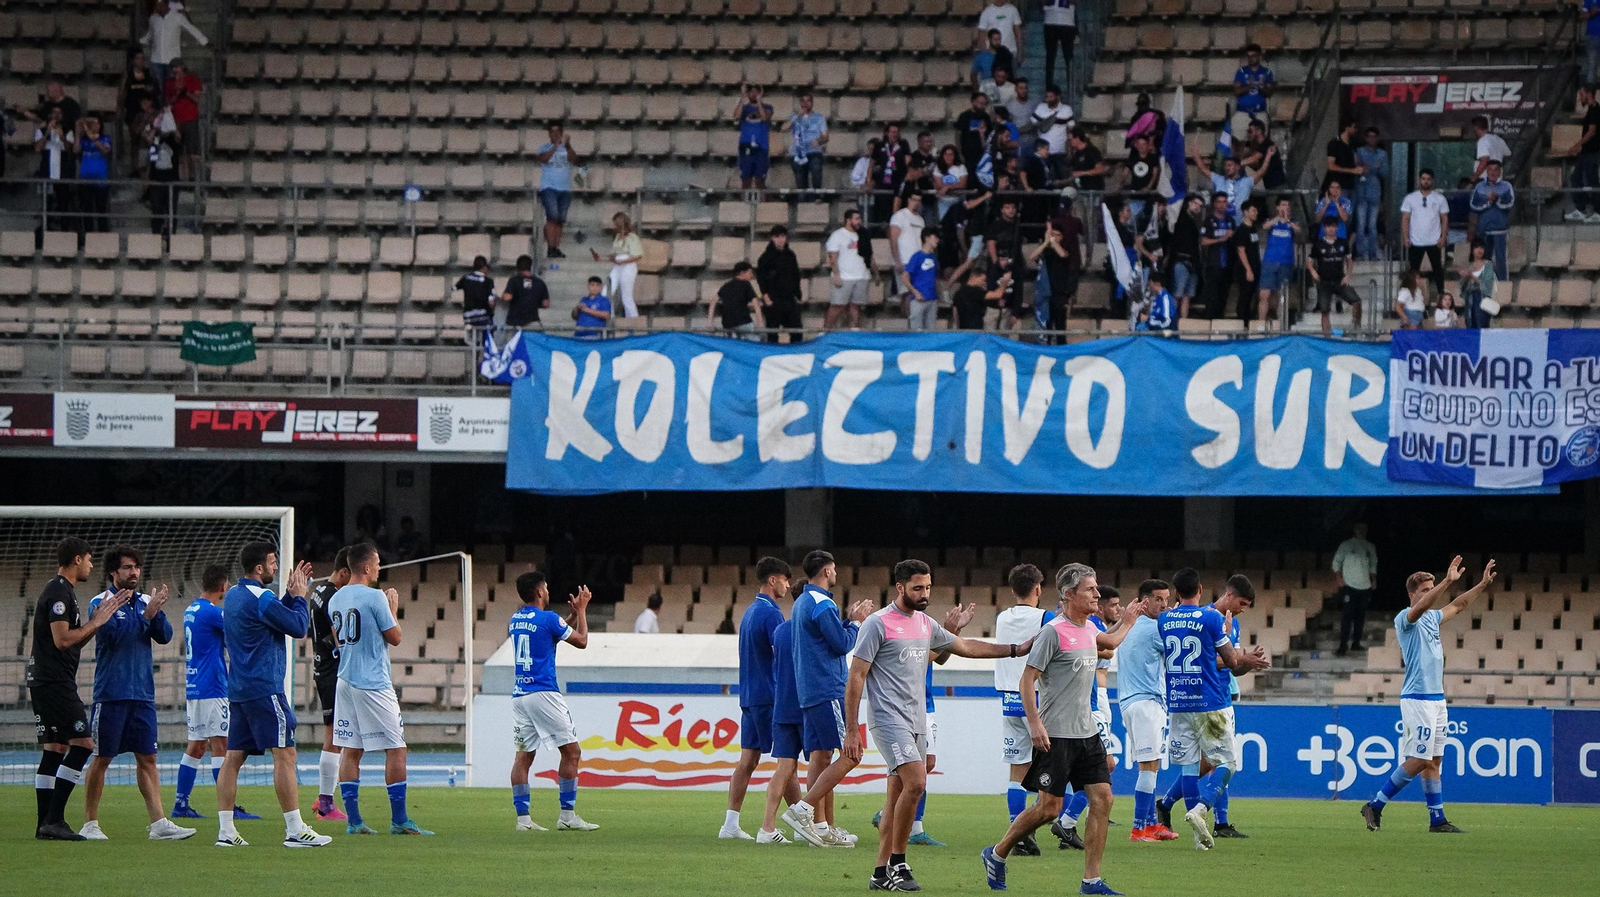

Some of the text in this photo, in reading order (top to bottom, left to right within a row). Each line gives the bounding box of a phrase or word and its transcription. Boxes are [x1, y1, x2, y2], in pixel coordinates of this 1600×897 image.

[1351, 80, 1524, 114] PLAY JEREZ
[1407, 351, 1533, 390] ANIMAR
[1544, 361, 1562, 389] A
[96, 413, 163, 422] Ayuntamiento
[190, 408, 380, 444] PLAY JEREZ
[545, 349, 1389, 469] KOLECTIVO SUR
[1403, 388, 1502, 427] EQUIPO
[1508, 391, 1556, 428] NO
[96, 422, 133, 431] de Jerez
[458, 426, 494, 436] de Jerez
[1401, 431, 1436, 462] UN
[1444, 431, 1561, 468] DELITO
[331, 607, 361, 648] 20
[1163, 620, 1187, 632] SERGIO
[1165, 634, 1203, 674] 22
[1416, 725, 1432, 741] 19
